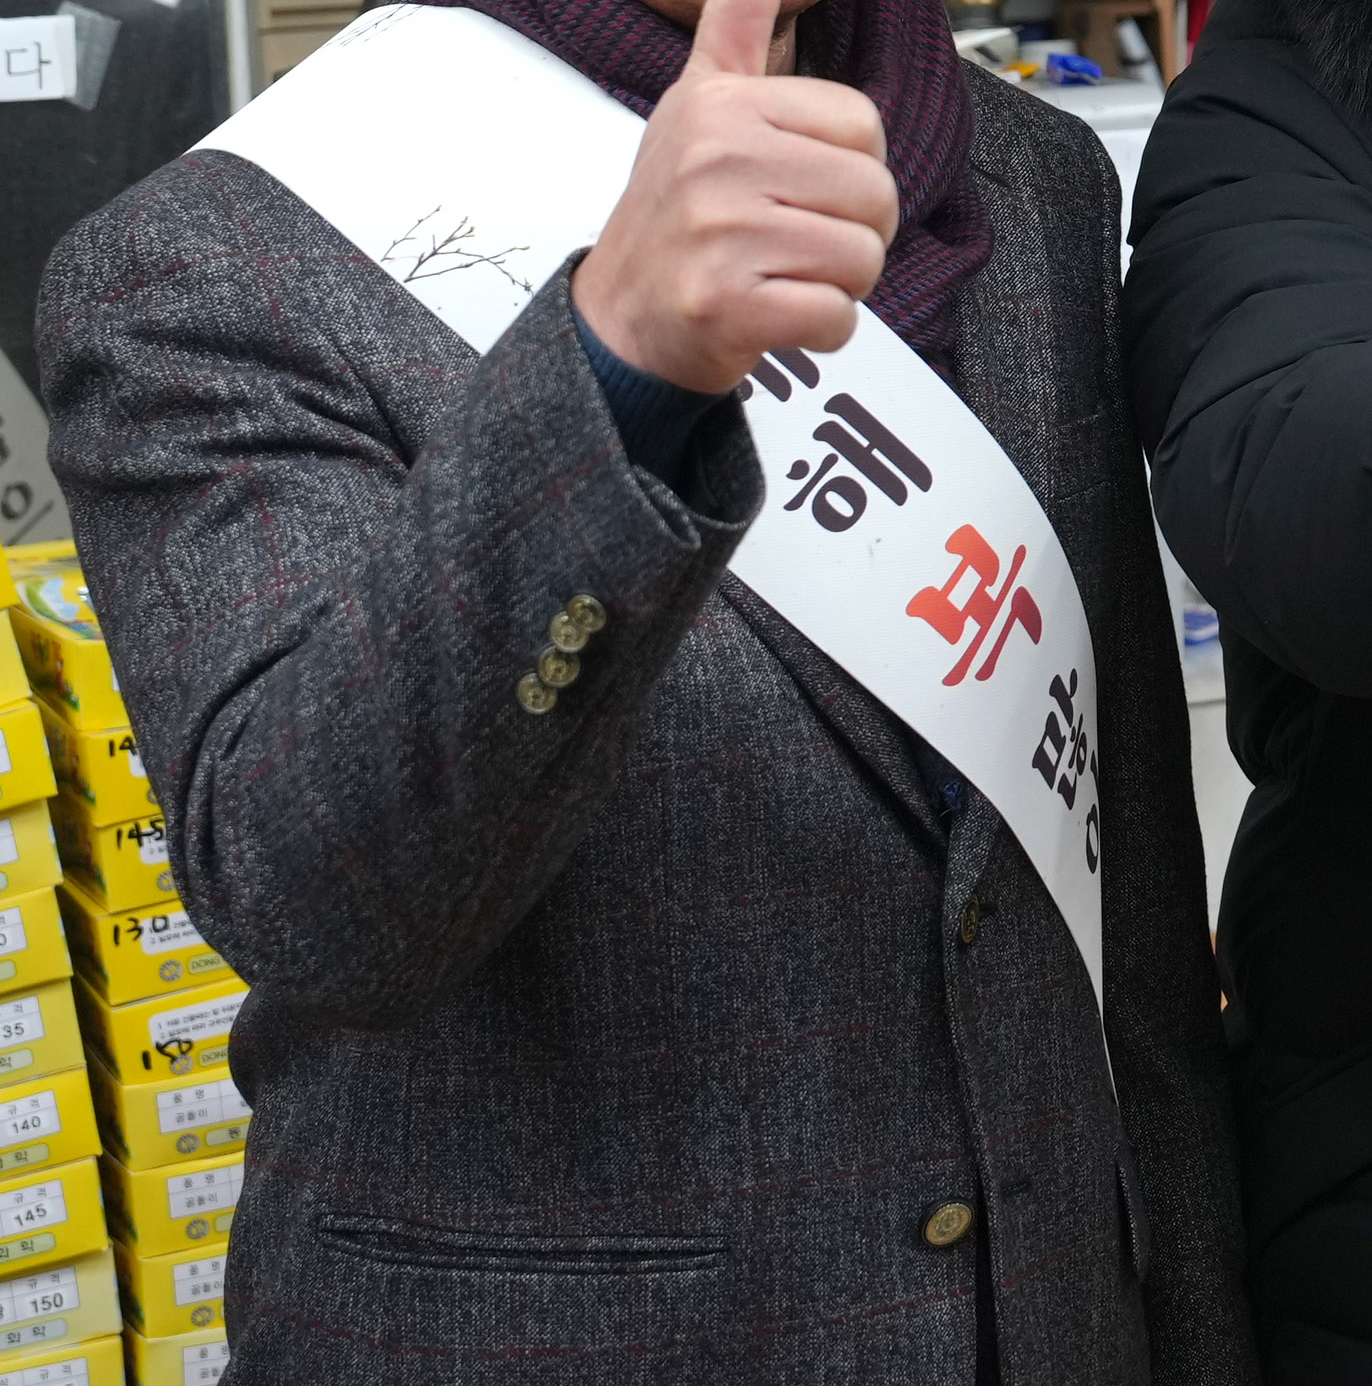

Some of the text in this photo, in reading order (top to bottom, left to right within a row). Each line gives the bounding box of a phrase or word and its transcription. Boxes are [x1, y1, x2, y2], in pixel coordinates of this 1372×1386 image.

[904, 522, 1043, 688] 복
[113, 914, 171, 947] 130
[12, 1115, 41, 1135] 140
[14, 1203, 48, 1227] 145
[30, 1292, 64, 1314] 150
